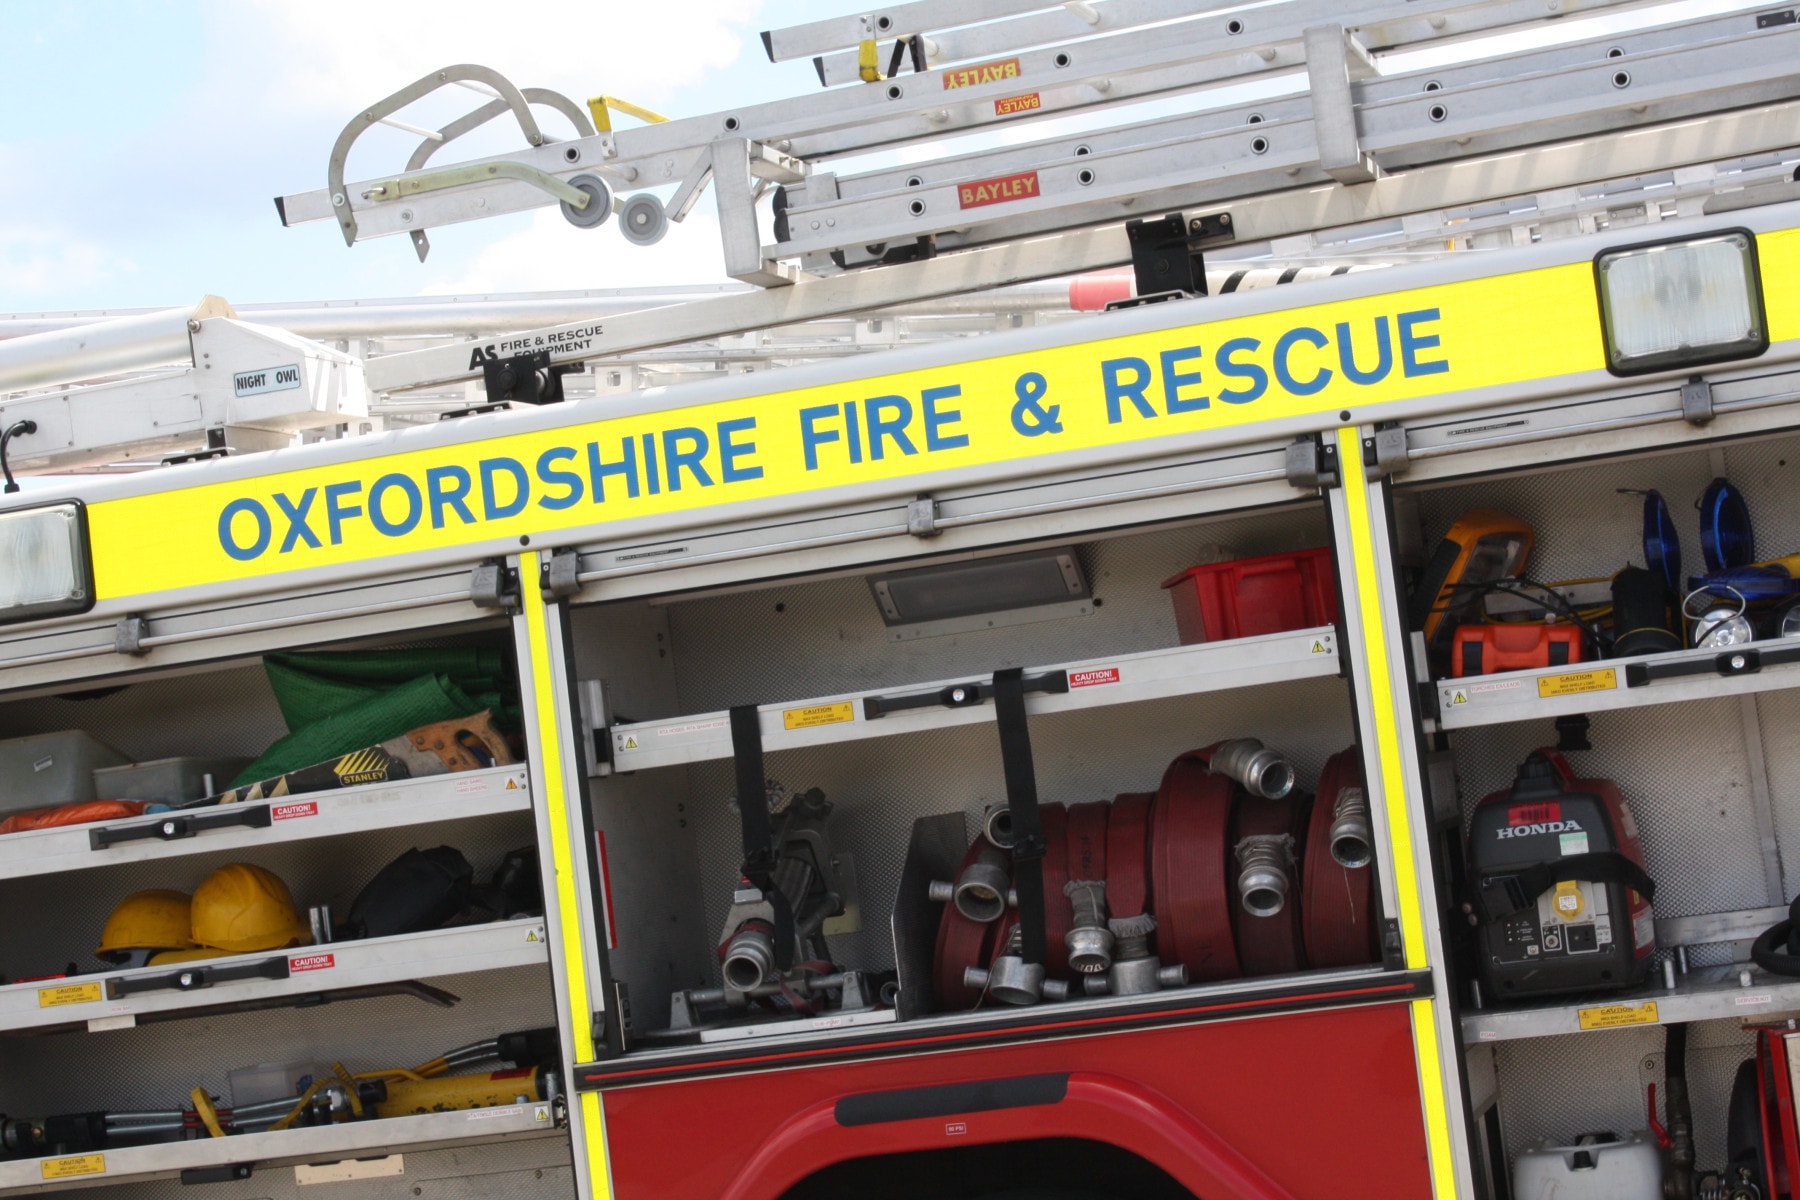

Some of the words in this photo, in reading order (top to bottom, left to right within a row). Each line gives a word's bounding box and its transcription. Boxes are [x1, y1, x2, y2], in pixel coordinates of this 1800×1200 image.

[948, 62, 1017, 89] BAYLEY
[997, 97, 1039, 115] BAYLEY
[961, 176, 1035, 205] BAYLEY
[501, 339, 531, 352] FIRE
[534, 336, 545, 346] &
[548, 325, 603, 344] RESCUE
[236, 373, 266, 390] NIGHT
[276, 369, 298, 384] OWL
[220, 418, 762, 559] OXFORDSHIRE
[801, 386, 967, 469] FIRE
[1013, 374, 1061, 435] &
[1103, 310, 1447, 422] RESCUE
[1075, 670, 1112, 682] CAUTION!
[1560, 673, 1592, 682] CAUTION
[803, 706, 832, 715] CAUTION
[343, 771, 384, 784] STANLEY
[1496, 820, 1583, 839] HONDA
[294, 955, 329, 967] CAUTION!
[56, 986, 83, 995] CAUTION
